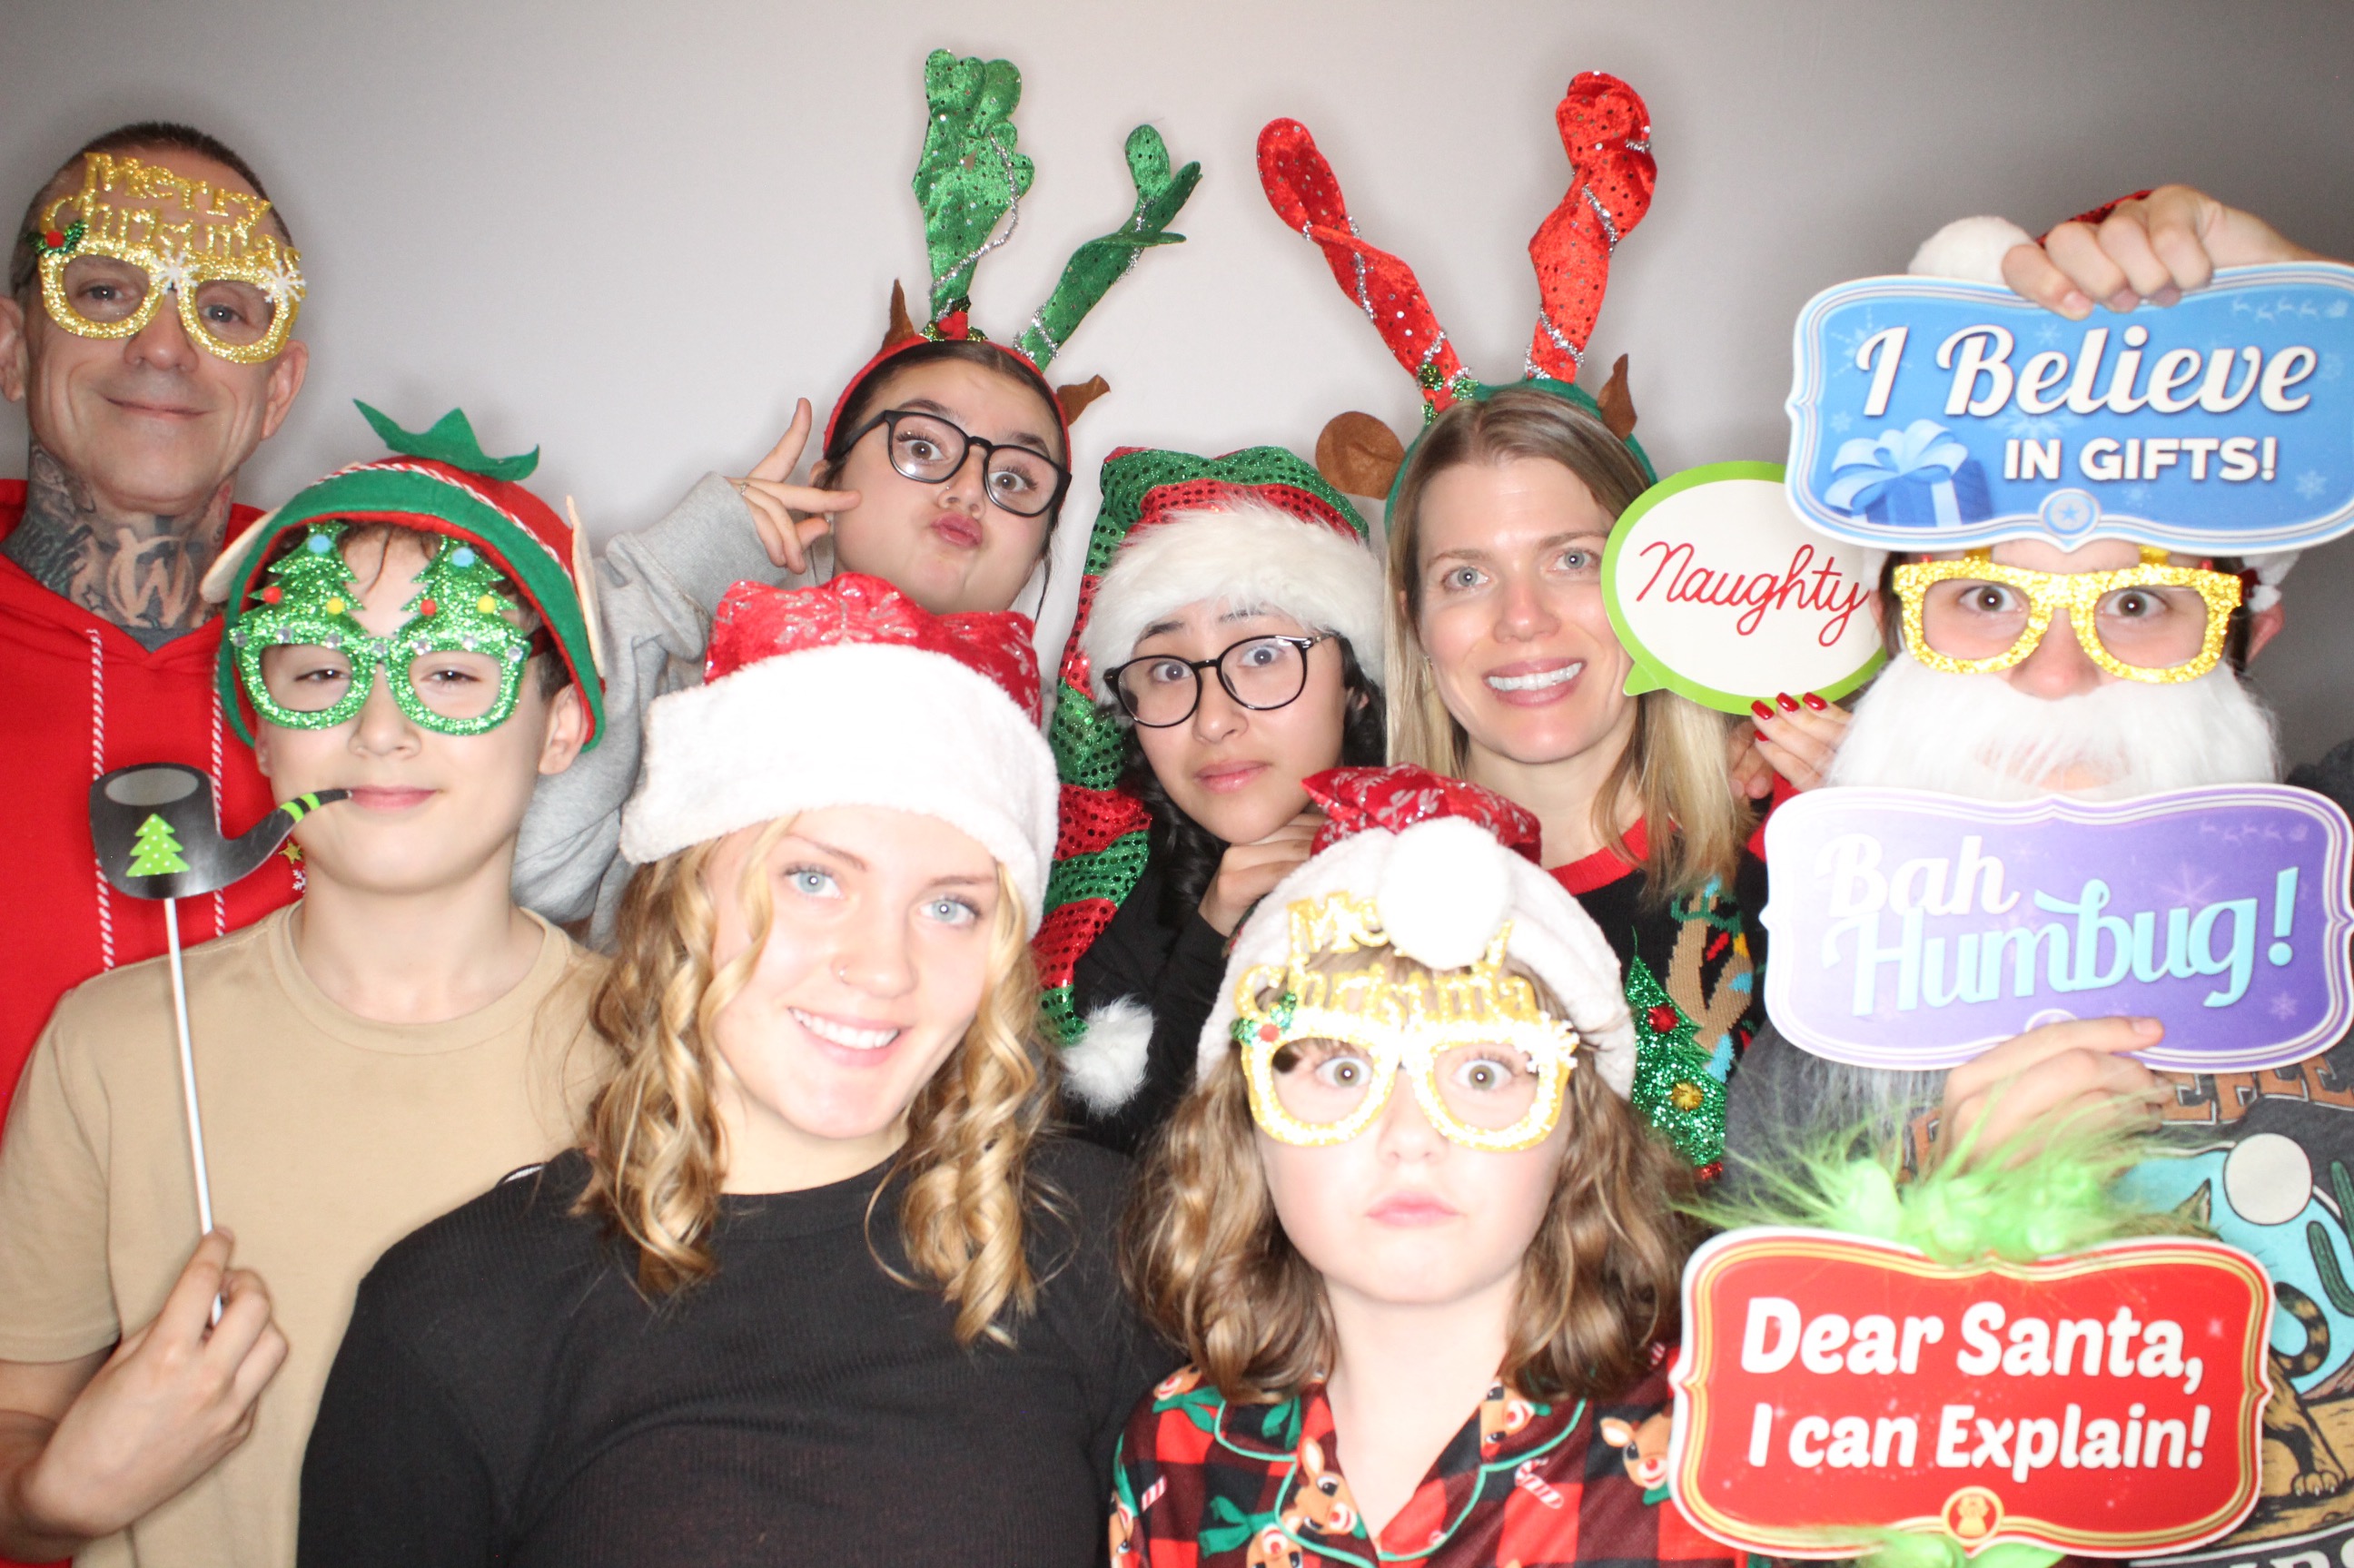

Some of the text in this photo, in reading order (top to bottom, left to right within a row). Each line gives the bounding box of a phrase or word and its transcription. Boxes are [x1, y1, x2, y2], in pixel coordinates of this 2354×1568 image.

[84, 152, 272, 221] Merry
[1855, 323, 2317, 417] I Believe
[2003, 436, 2278, 481] IN GIFTS!
[1636, 540, 1872, 647] Naughty
[1816, 832, 2020, 918] Bah
[1820, 865, 2300, 1018] Humbug!
[1234, 953, 1555, 1024] Christma
[1740, 1297, 2204, 1395] Dear Santa,
[1748, 1402, 2212, 1484] I can Explain!
